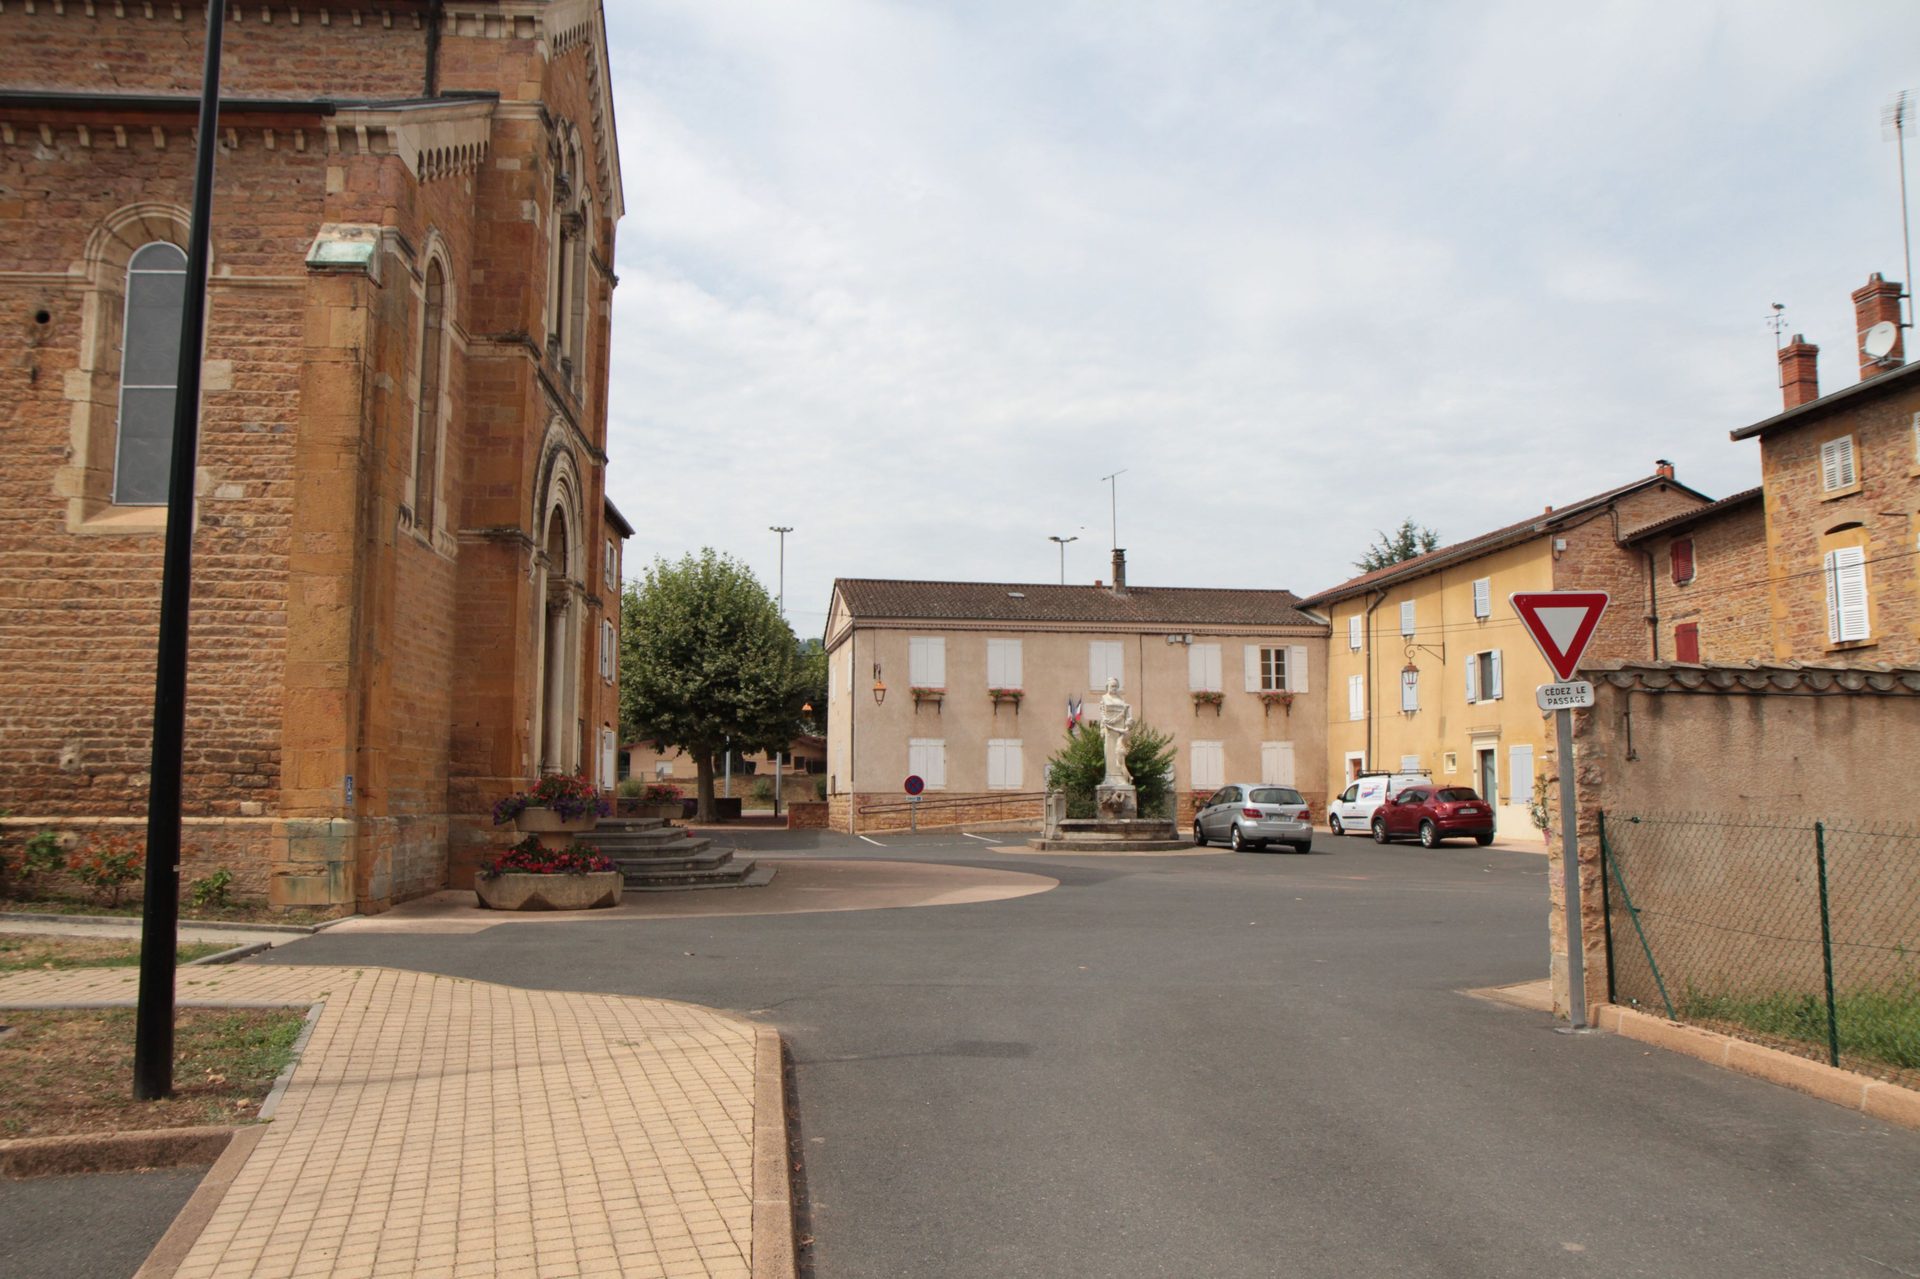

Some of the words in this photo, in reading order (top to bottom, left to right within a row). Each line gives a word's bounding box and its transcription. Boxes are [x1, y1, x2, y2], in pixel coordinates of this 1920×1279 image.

[1544, 687, 1571, 696] CÉDEZ
[1576, 686, 1586, 694] LE
[1548, 696, 1586, 705] PASSAGE
